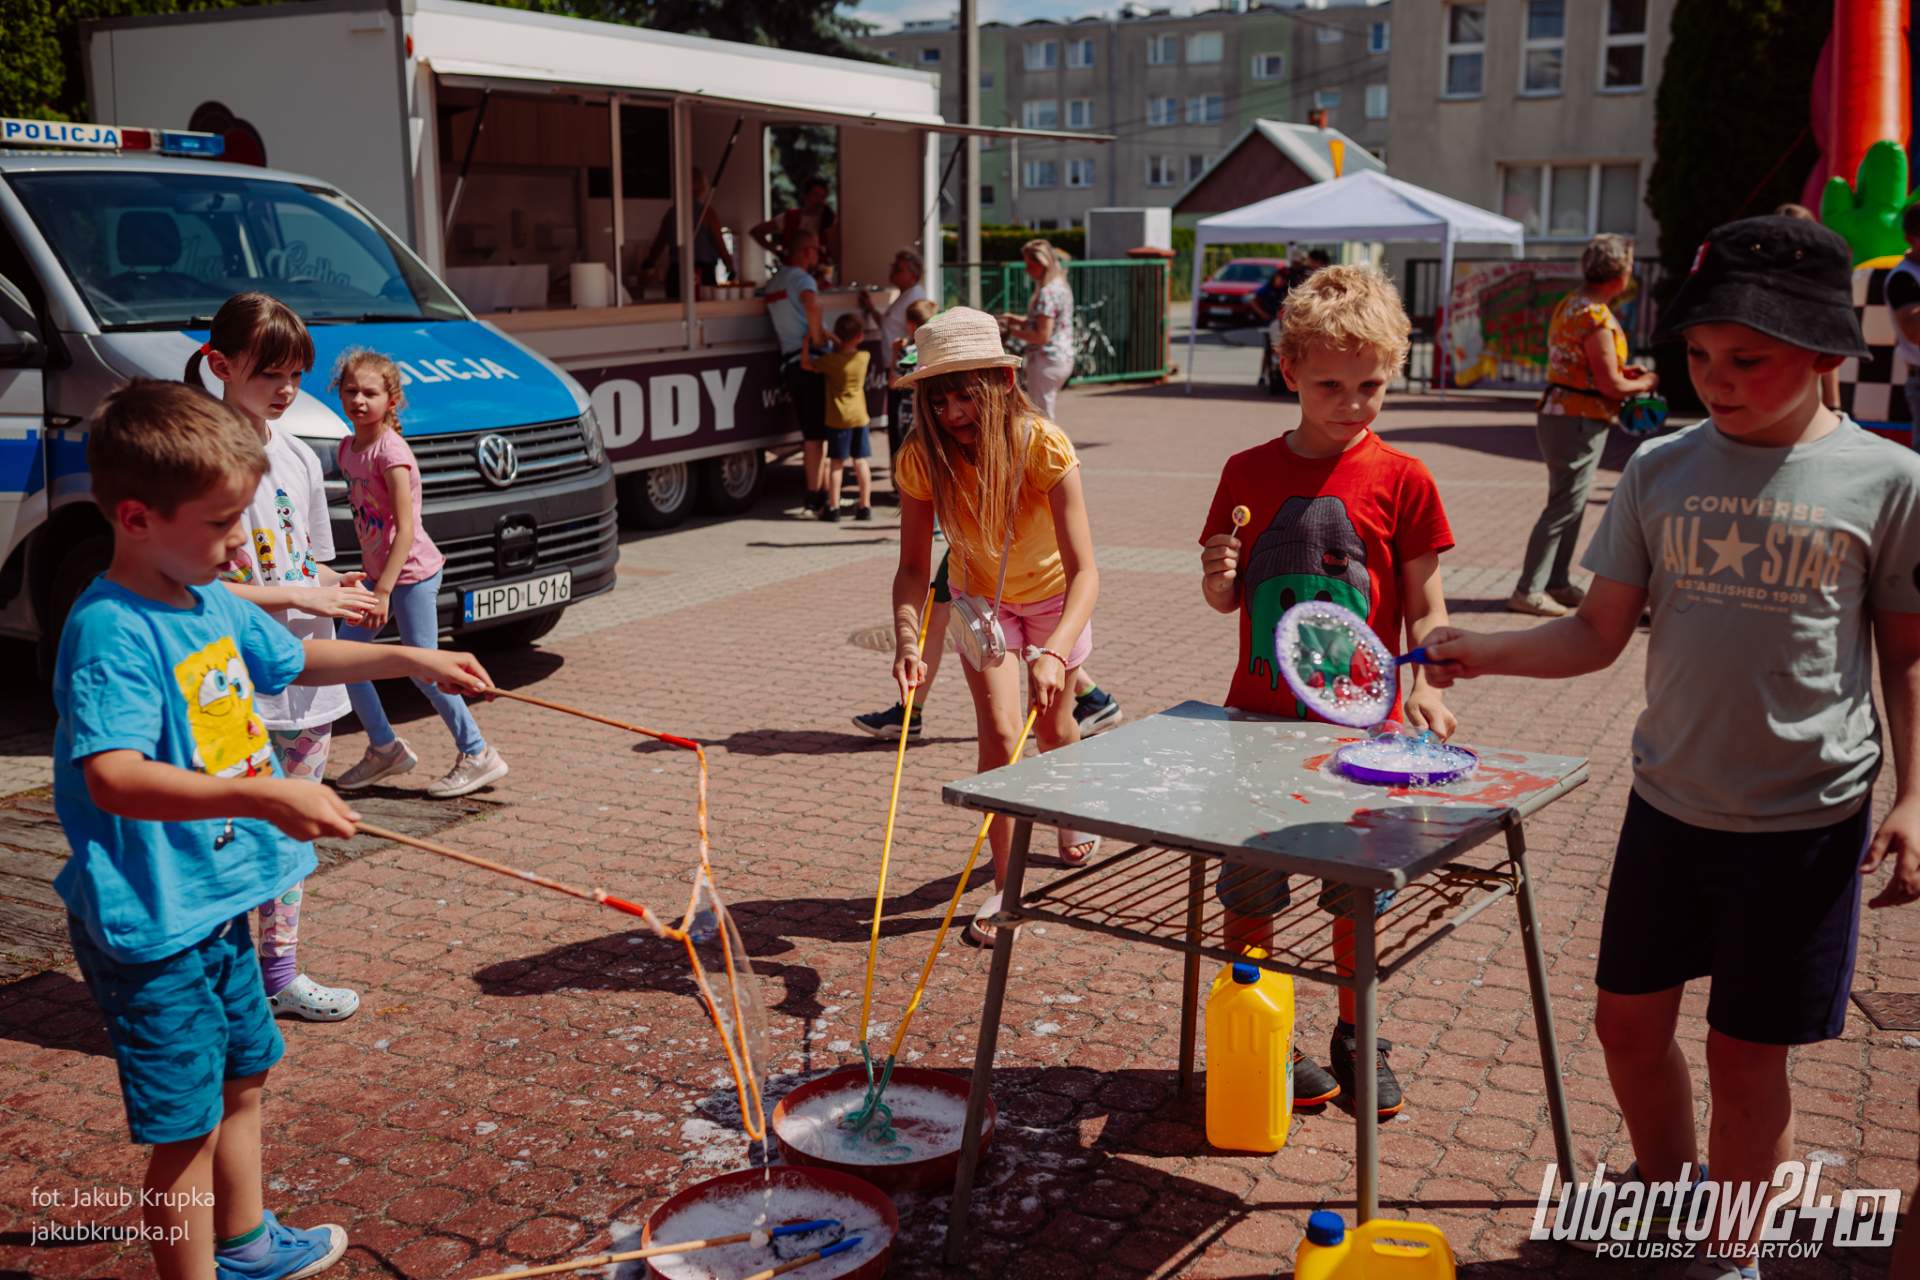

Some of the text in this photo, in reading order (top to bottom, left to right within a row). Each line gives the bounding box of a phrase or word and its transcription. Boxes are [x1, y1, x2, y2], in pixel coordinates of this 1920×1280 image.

[5, 121, 118, 145] POLICJA
[398, 357, 520, 385] LICJA
[591, 366, 747, 448] ODY
[1684, 495, 1825, 523] CONVERSE
[1663, 515, 1850, 591] ALL STAR
[477, 576, 569, 618] HPD L916
[1675, 579, 1768, 600] ESTABLISHED
